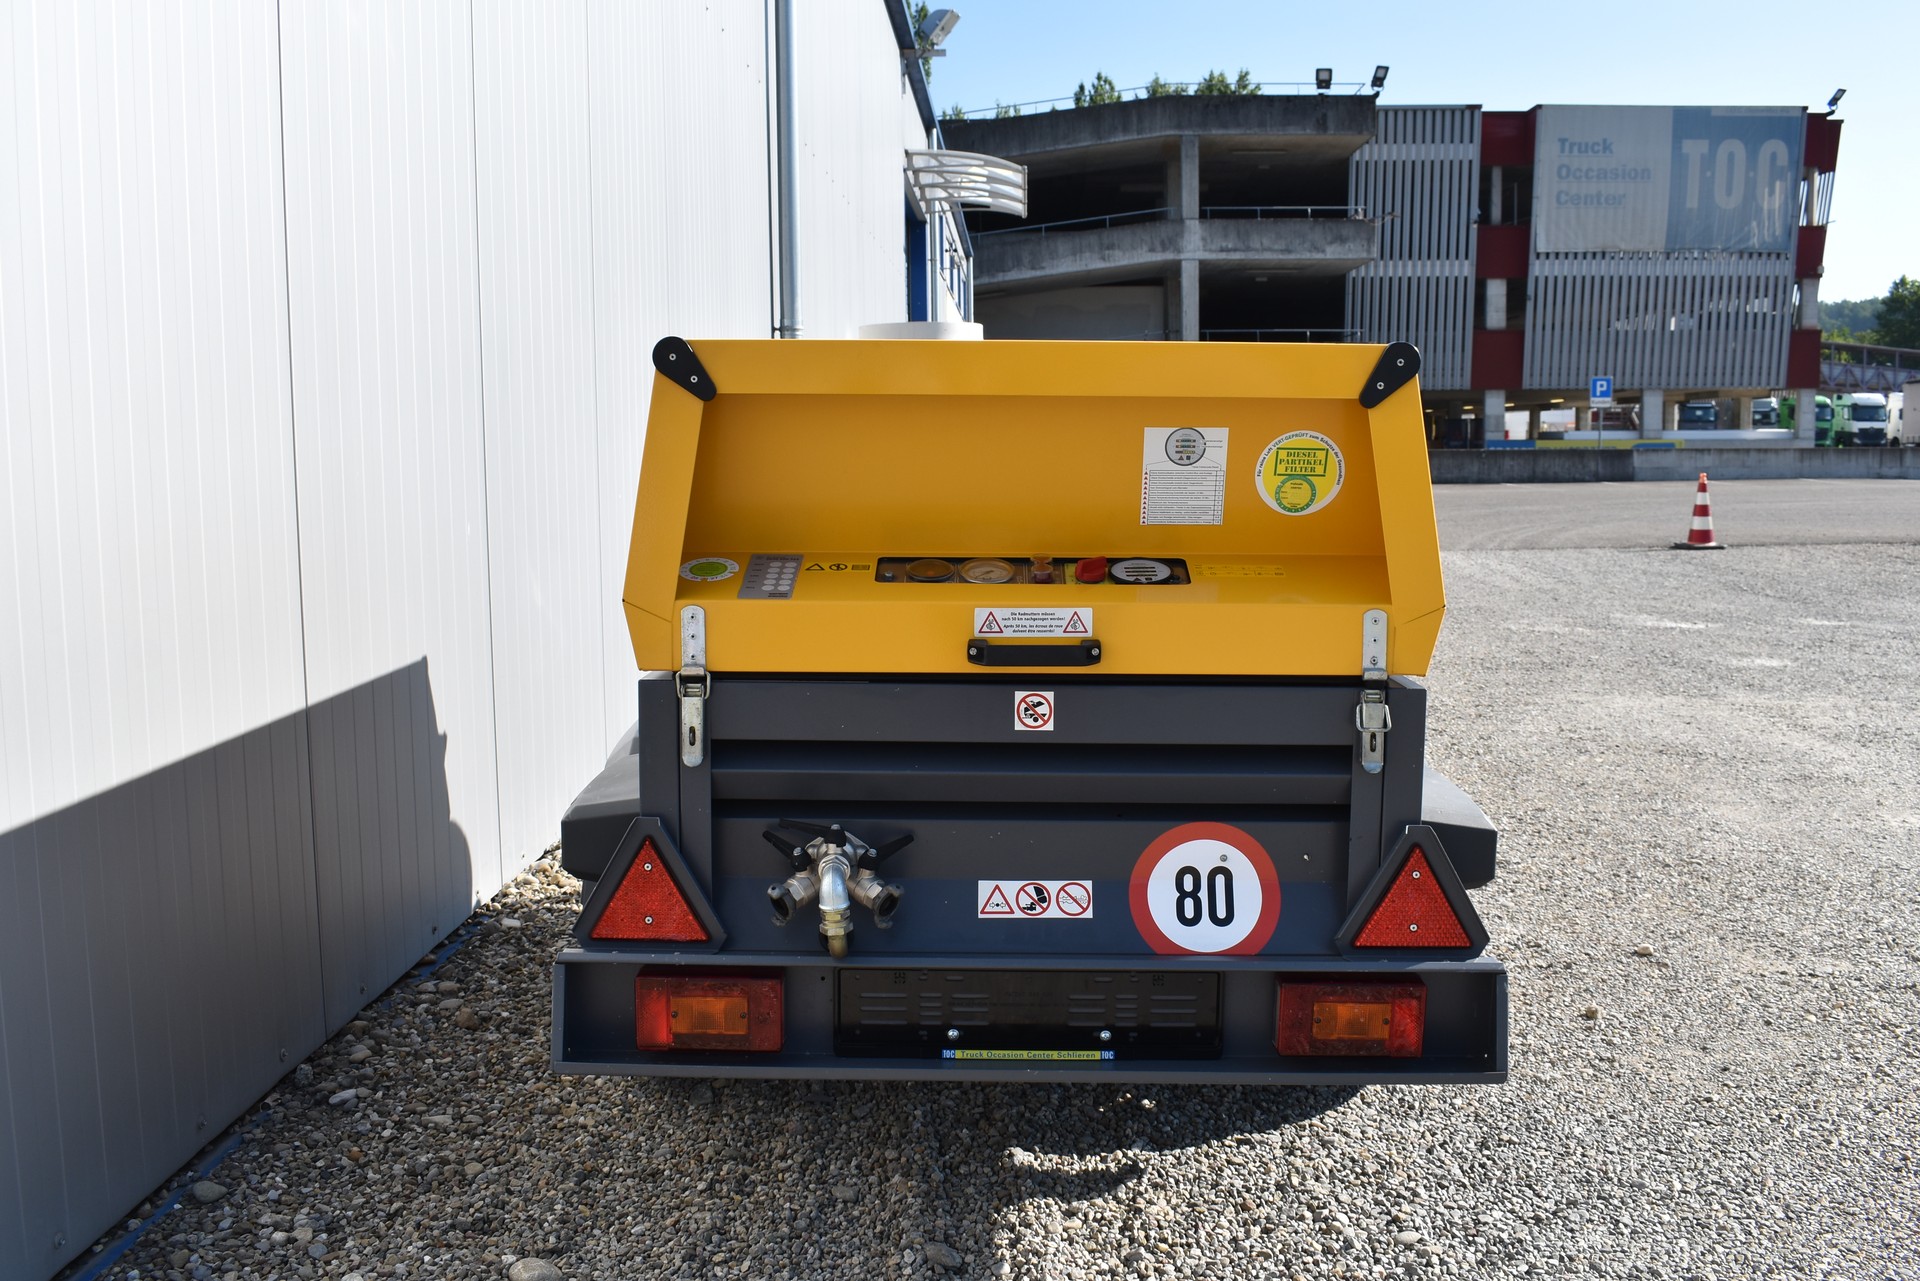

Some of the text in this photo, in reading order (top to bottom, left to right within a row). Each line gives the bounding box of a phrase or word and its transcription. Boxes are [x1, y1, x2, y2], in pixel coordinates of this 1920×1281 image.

[1557, 137, 1614, 155] Truck
[1556, 164, 1651, 181] Occasion
[1556, 190, 1626, 207] Center
[1596, 381, 1607, 397] P
[1264, 447, 1273, 457] Luft
[1279, 458, 1324, 466] PARTIKEL
[1175, 866, 1235, 927] 80
[943, 1050, 955, 1058] TOC
[986, 1051, 1024, 1059] Occasion
[1101, 1051, 1114, 1059] TOC
